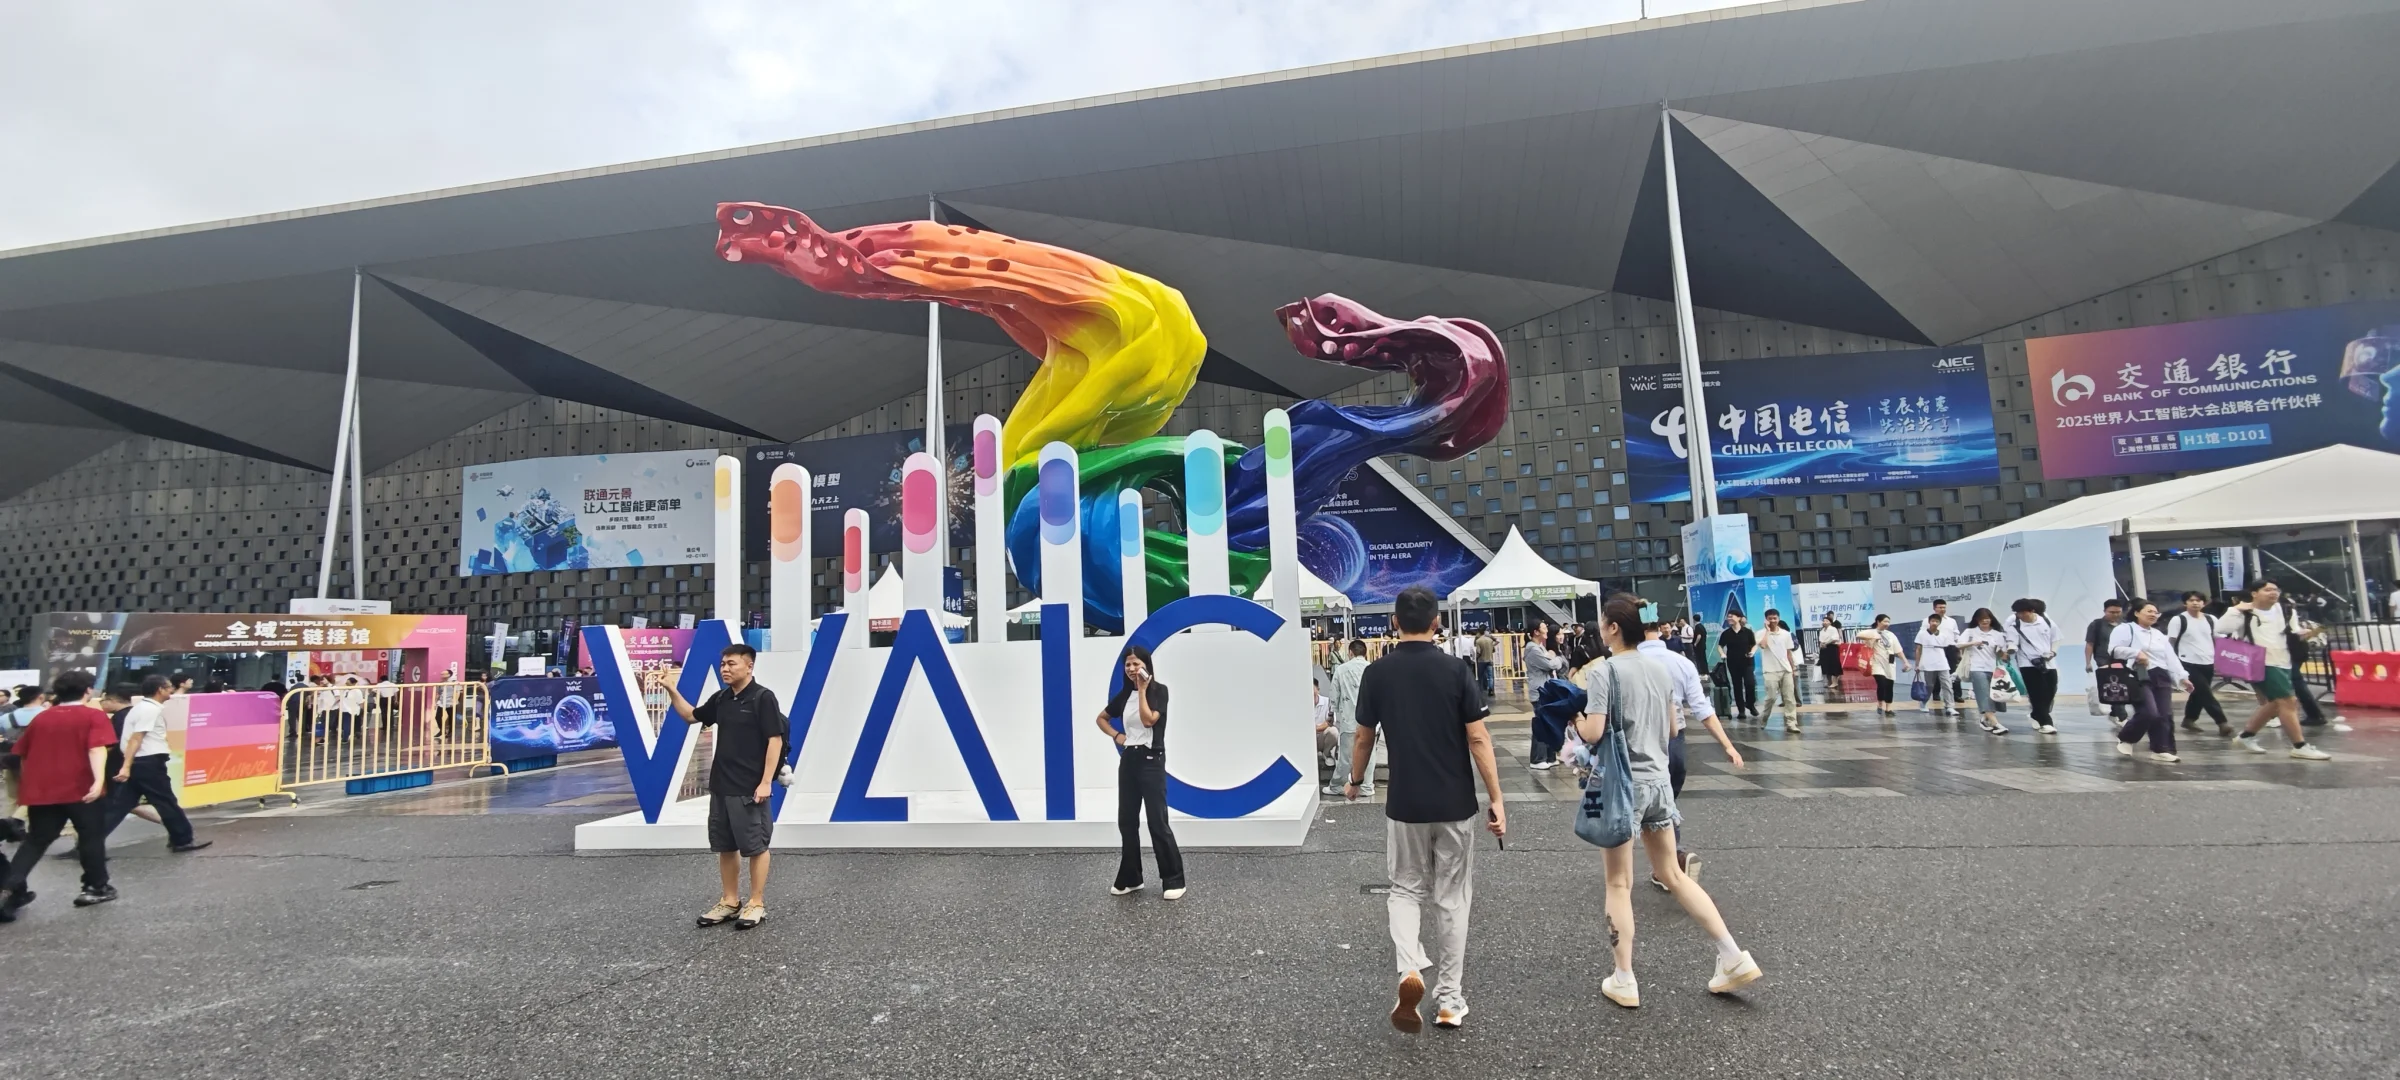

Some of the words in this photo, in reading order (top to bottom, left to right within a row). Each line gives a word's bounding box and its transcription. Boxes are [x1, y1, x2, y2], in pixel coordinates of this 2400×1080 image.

[1936, 356, 1975, 368] AIEC
[2115, 349, 2297, 389] 交通銀行
[1630, 382, 1657, 391] WAIC
[2103, 391, 2143, 403] BANK
[2151, 388, 2171, 398] OF
[2178, 374, 2318, 396] COMMUNICATIONS
[2056, 393, 2322, 428] 2025世界人工智能大会战略合作伙伴
[1718, 400, 1851, 443] 中国电信
[2184, 430, 2267, 445] H1馆-D101
[1721, 442, 1773, 456] CHINA
[1776, 438, 1853, 453] TELECOM
[2119, 443, 2177, 454] 上海世博展览馆
[583, 488, 632, 501] 联通元景
[583, 498, 681, 514] 让人工智能更简单
[1369, 543, 1394, 551] GLOBAL
[1395, 541, 1433, 549] SOLIDARITY
[1903, 579, 1932, 590] 384超节点
[227, 620, 278, 639] 全域
[303, 628, 370, 645] 链接馆
[495, 698, 527, 710] WAIC
[527, 696, 553, 708] 2025
[580, 595, 1303, 824] WAIC
